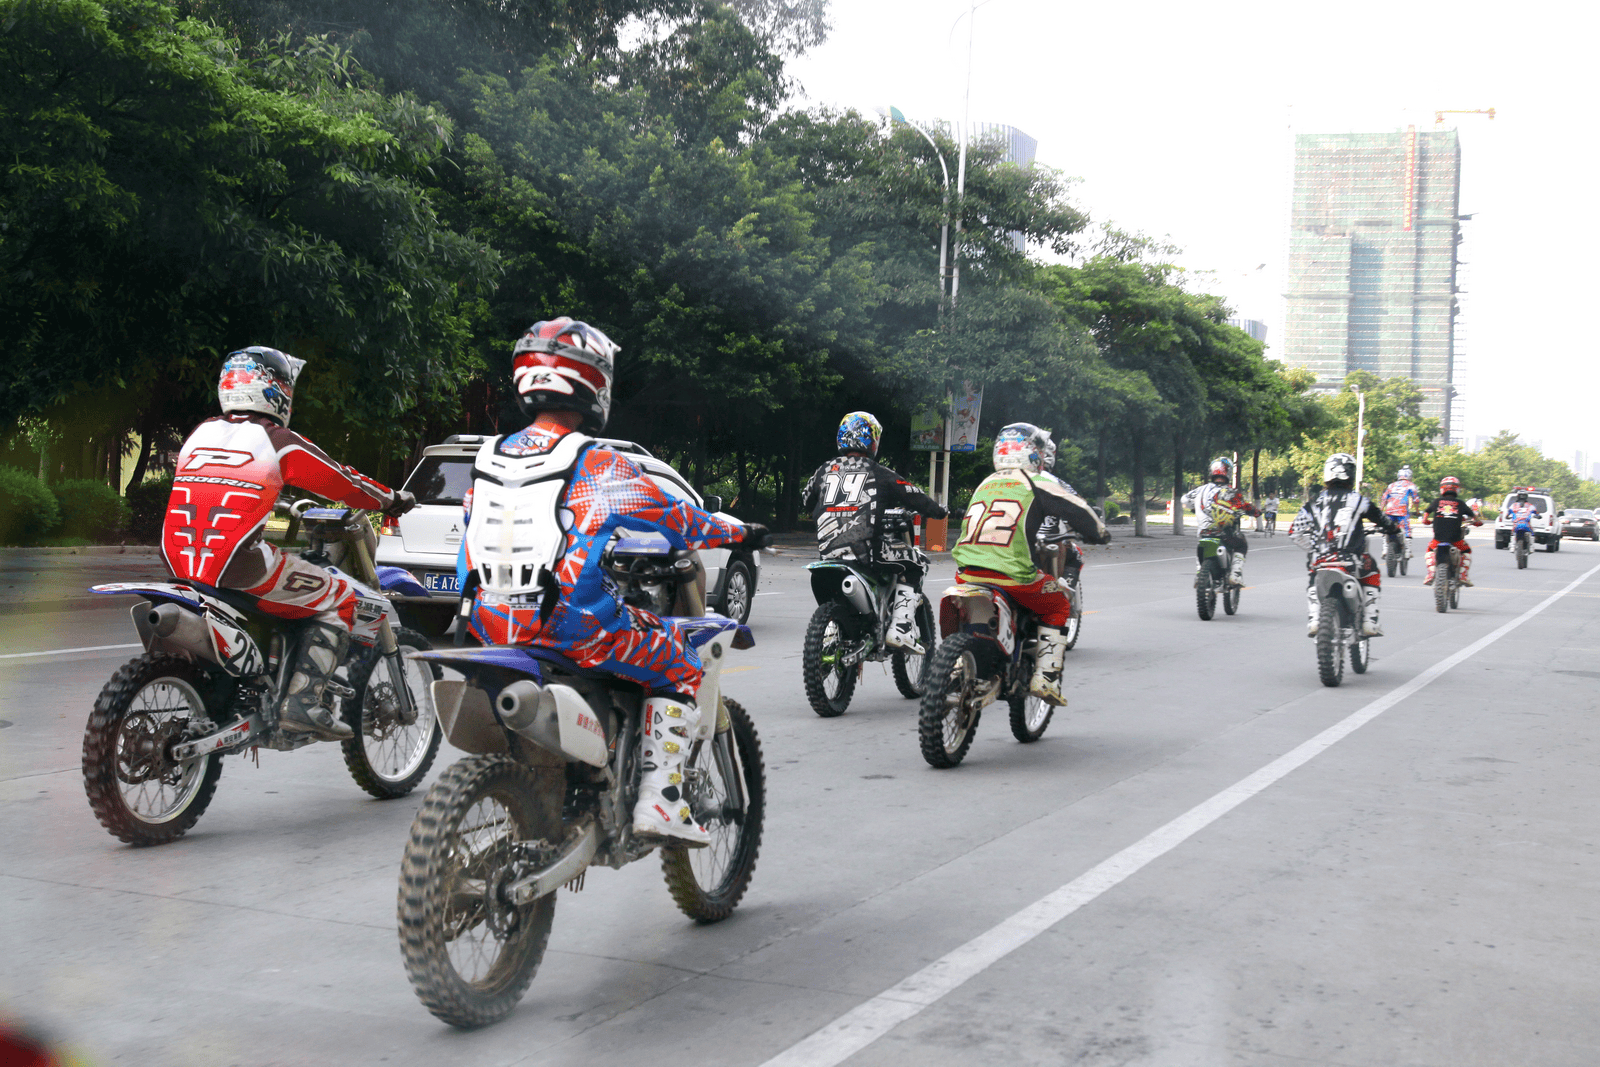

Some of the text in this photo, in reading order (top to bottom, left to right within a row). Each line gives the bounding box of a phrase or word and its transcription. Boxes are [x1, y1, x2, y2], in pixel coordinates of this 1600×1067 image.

[173, 475, 265, 491] PROGRIP
[823, 471, 869, 506] 14
[958, 499, 1024, 547] 12
